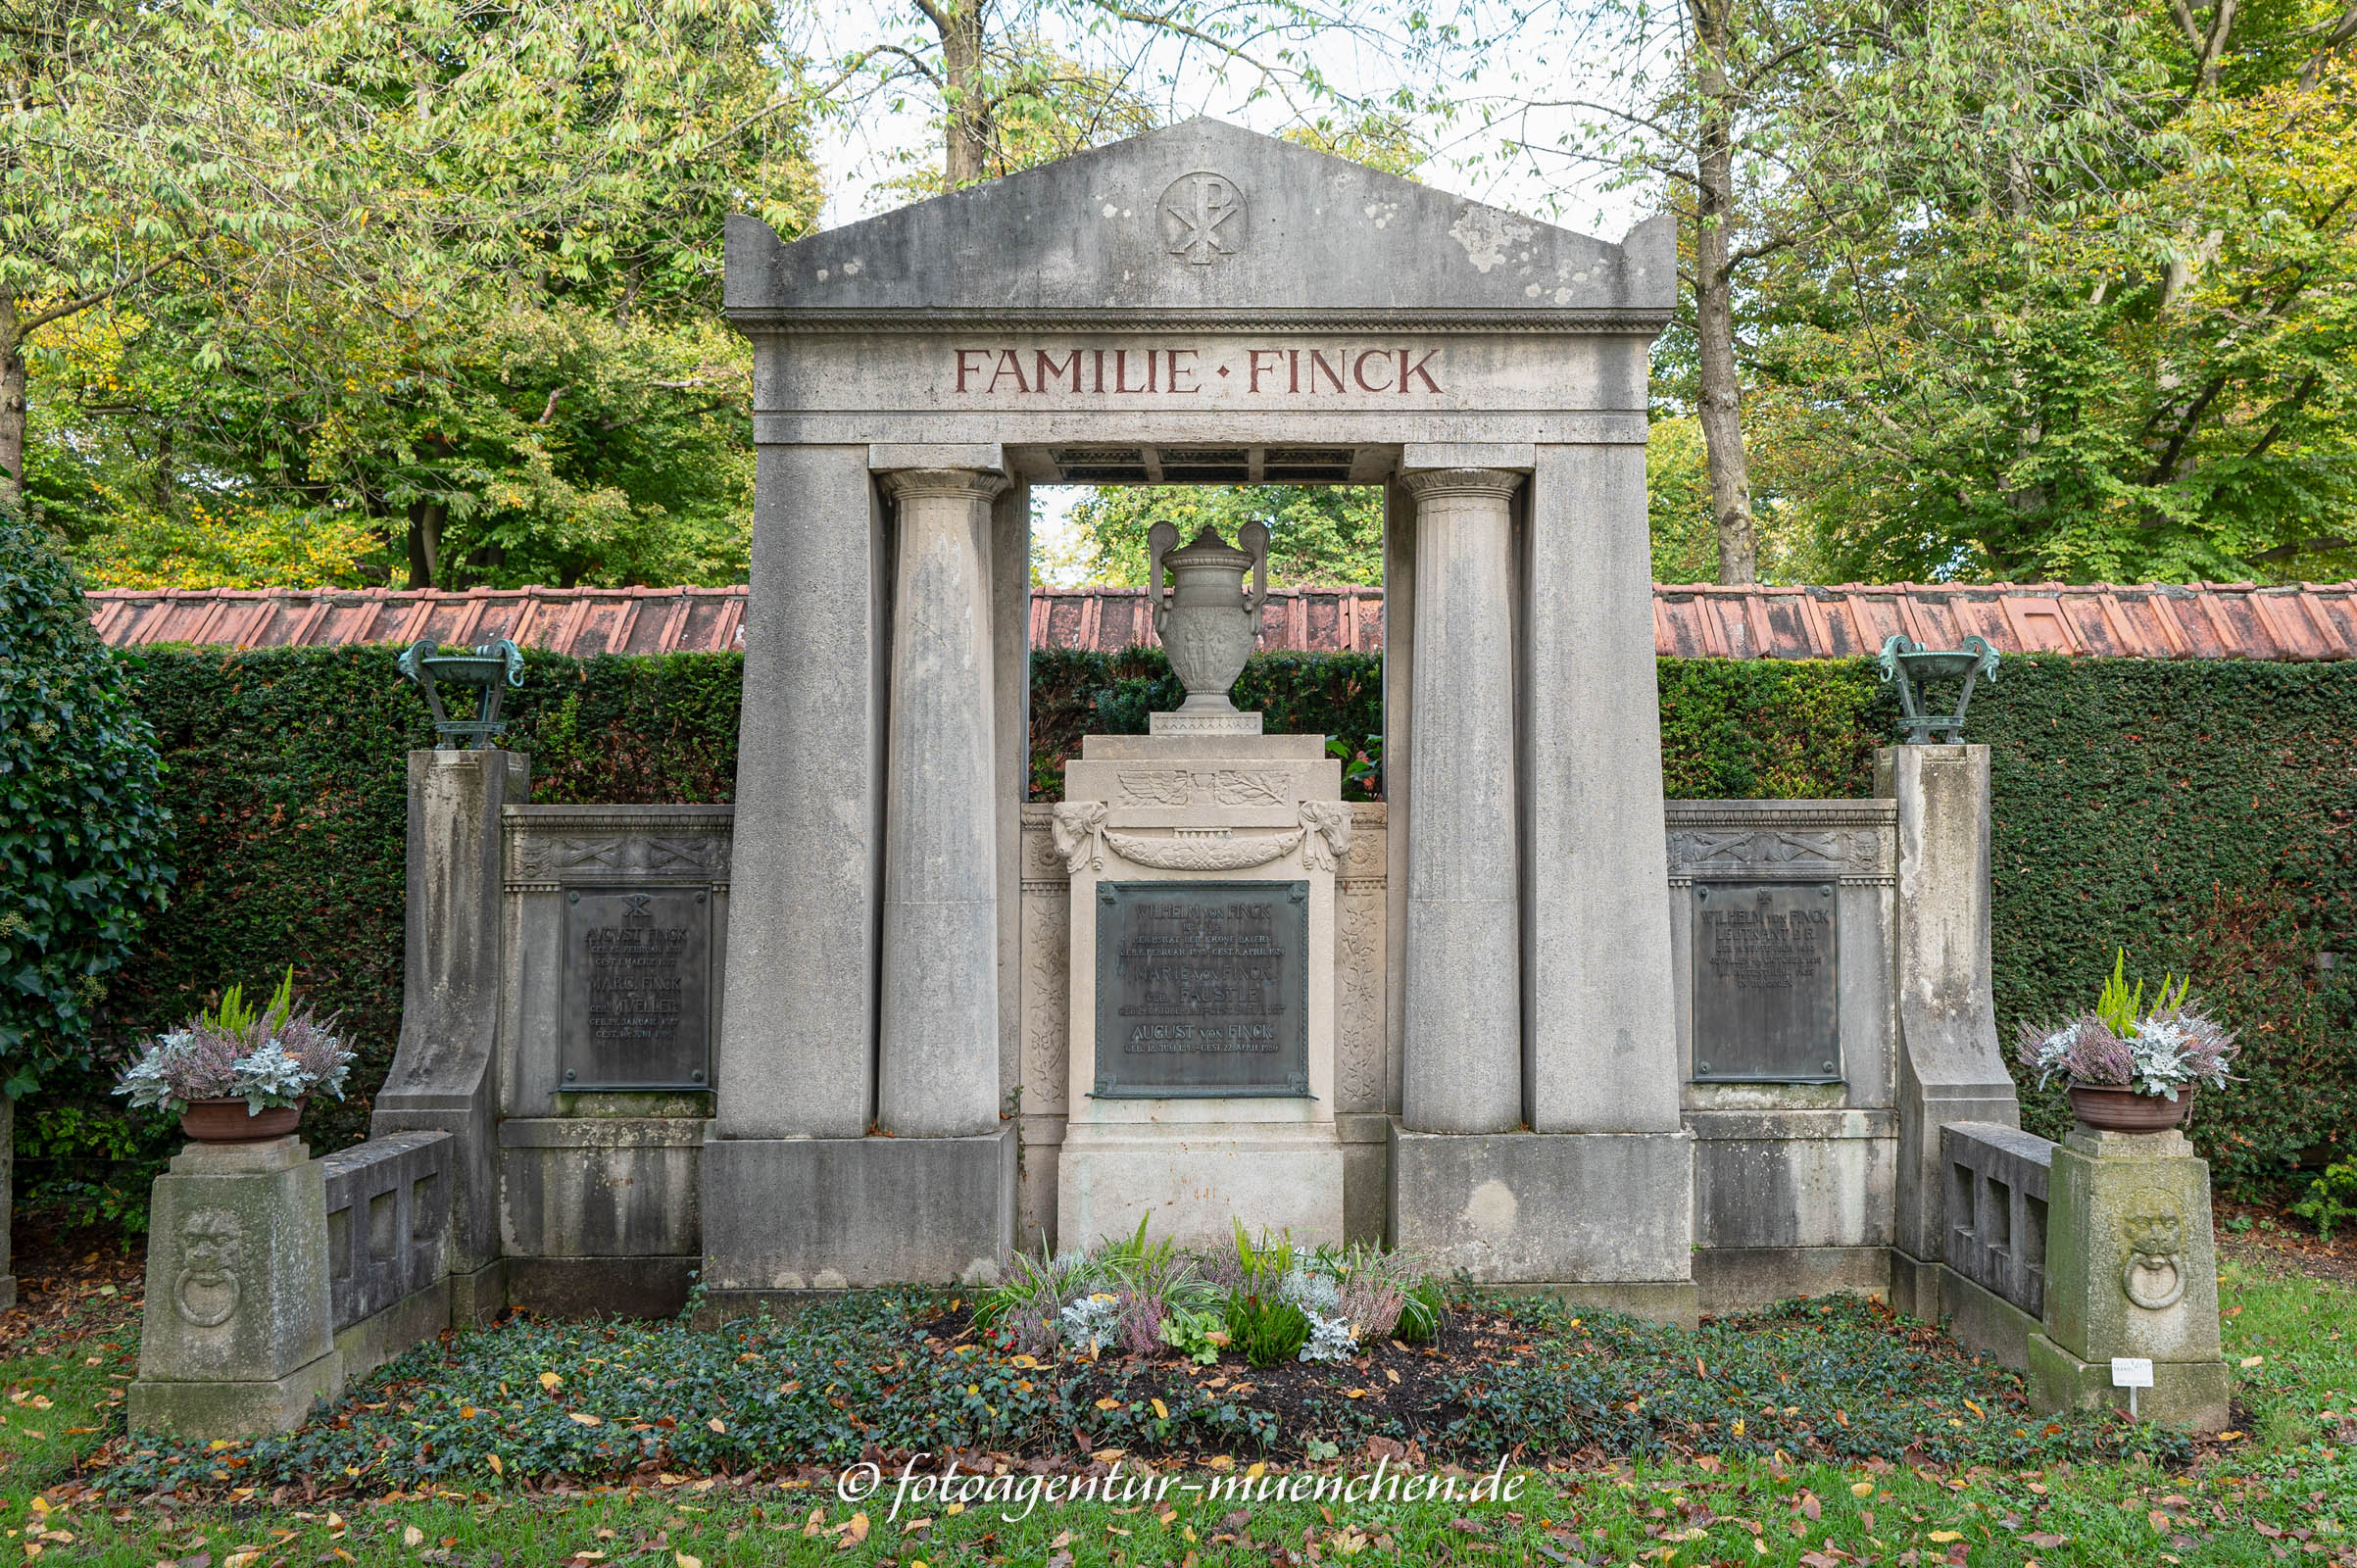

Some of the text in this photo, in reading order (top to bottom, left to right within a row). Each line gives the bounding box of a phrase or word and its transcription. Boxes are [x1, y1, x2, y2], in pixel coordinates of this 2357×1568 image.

[955, 349, 1446, 393] FAMILIE FINCK
[1135, 904, 1200, 919] WILHELM
[1227, 904, 1272, 919] FINCK
[1700, 909, 1764, 924] WILHELM
[1790, 909, 1830, 924] FINCK
[1135, 965, 1188, 981] MARIE
[1222, 965, 1272, 981] FINCK
[642, 976, 682, 991] FINCK
[1131, 1025, 1195, 1041] AUGUST
[1227, 1025, 1273, 1041] FINCK
